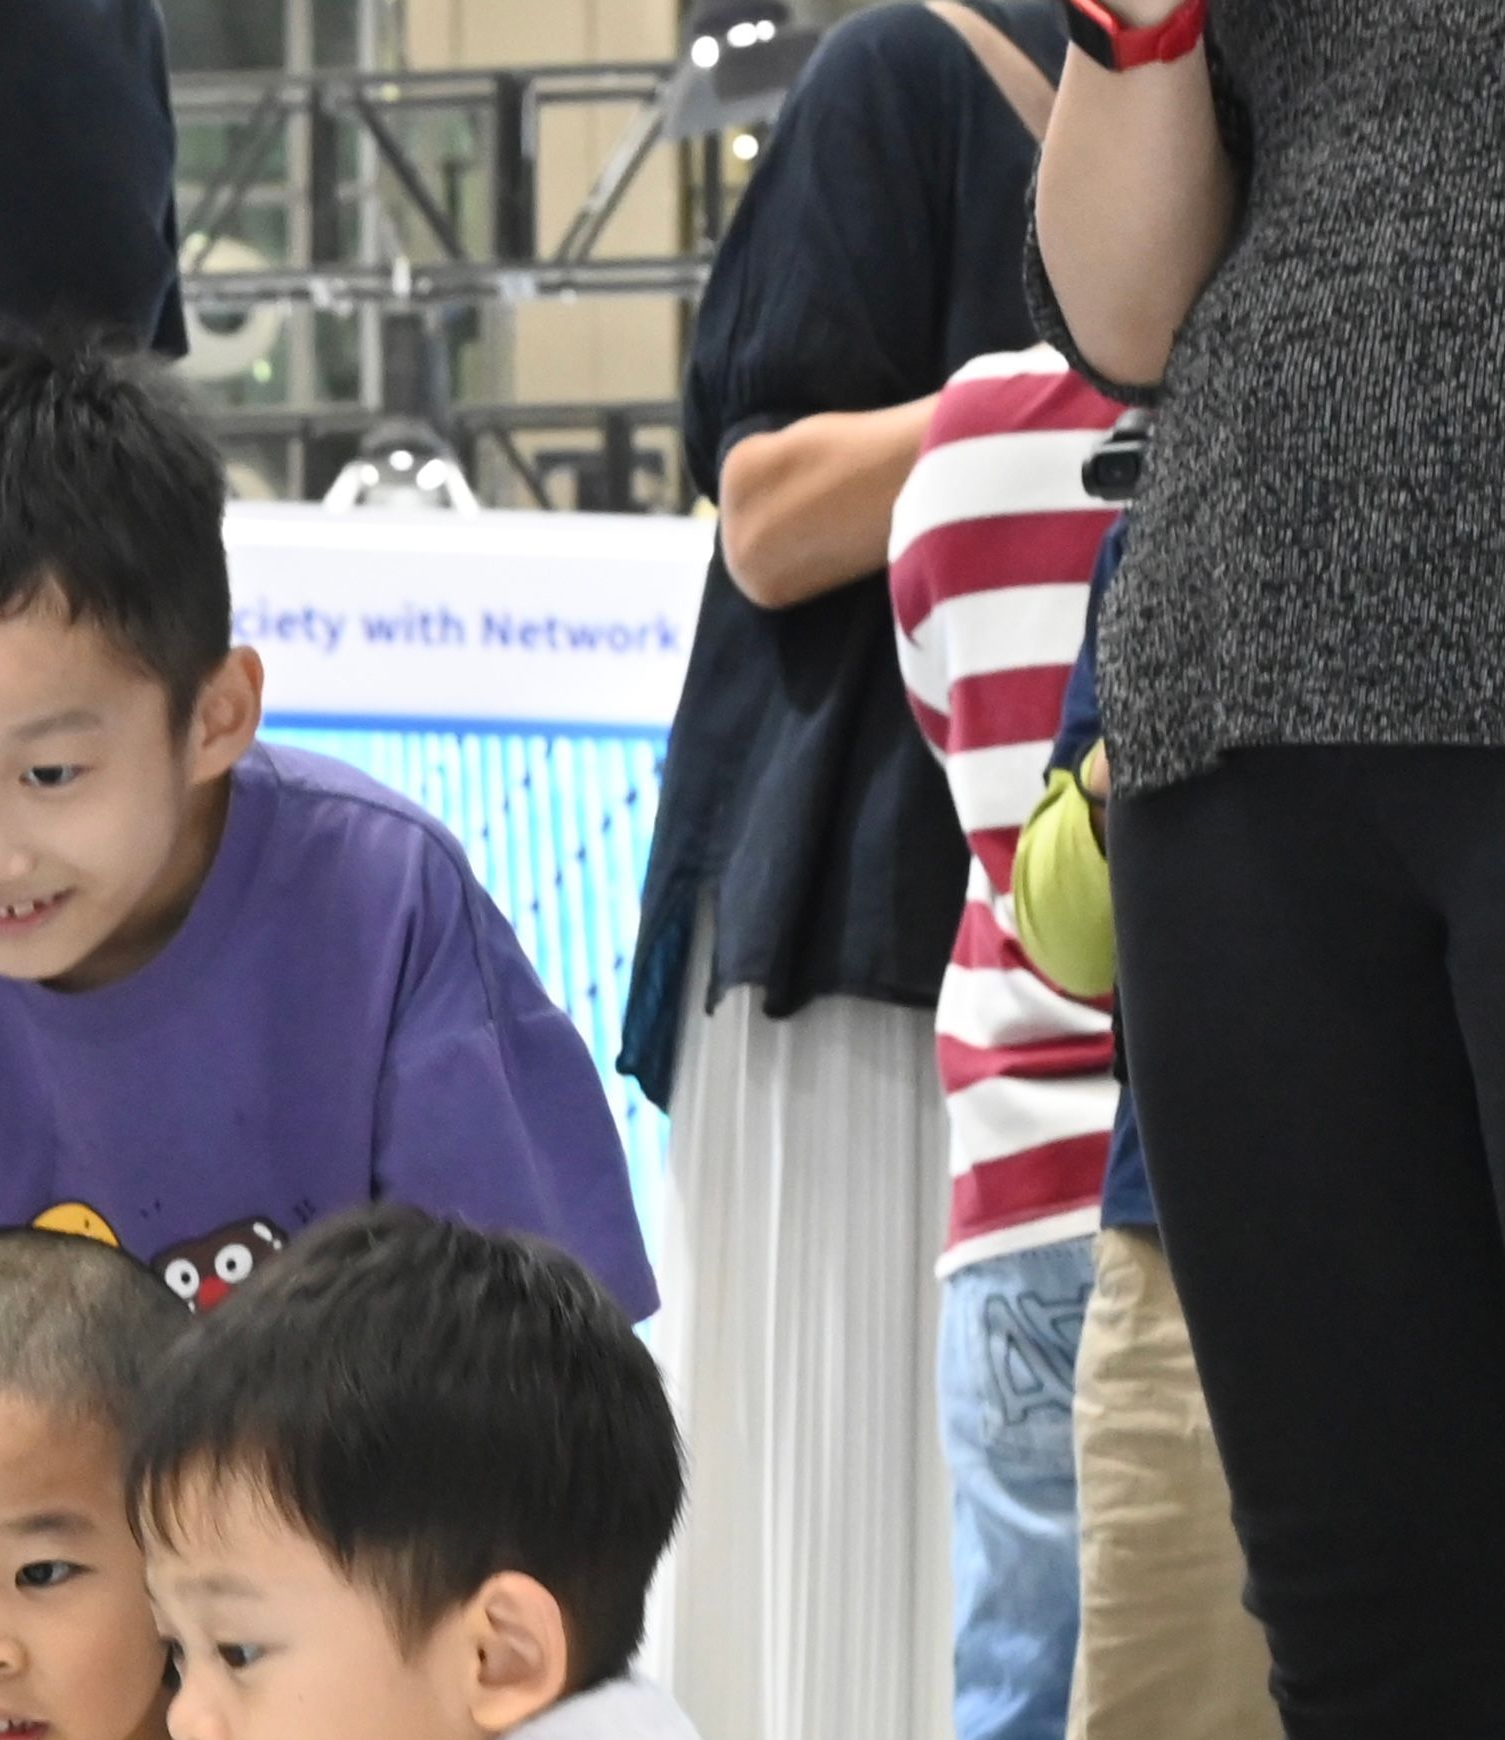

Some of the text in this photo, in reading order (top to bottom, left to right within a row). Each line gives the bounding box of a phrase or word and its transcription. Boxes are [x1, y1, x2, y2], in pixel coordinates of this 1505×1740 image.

[232, 598, 681, 655] ciety with Network
